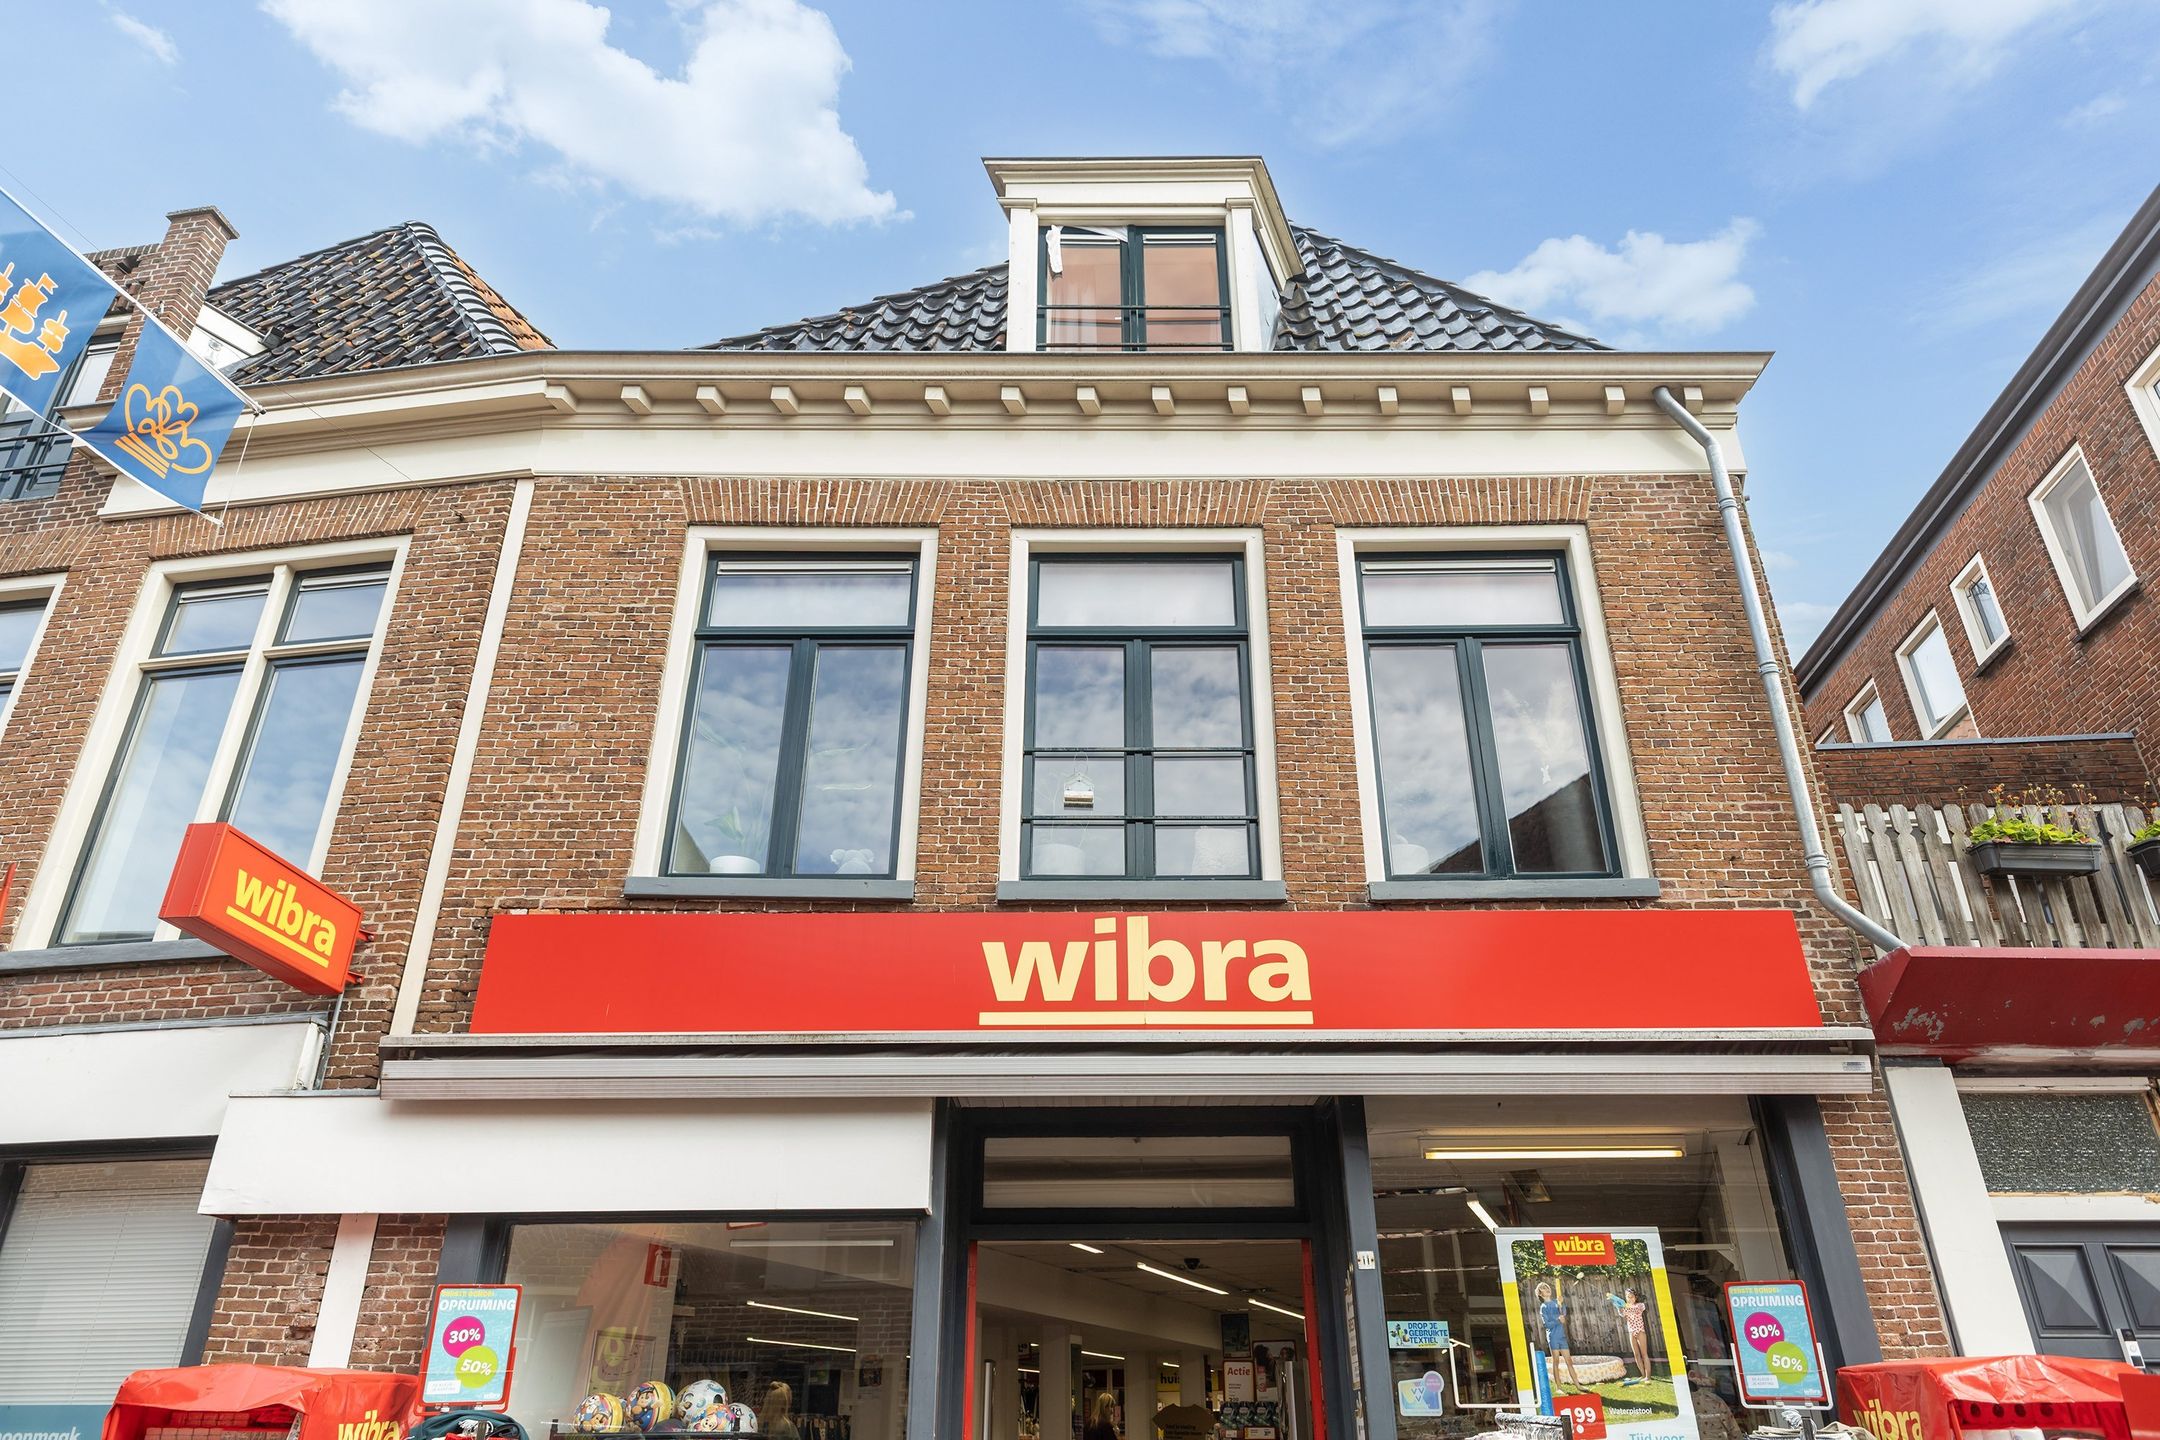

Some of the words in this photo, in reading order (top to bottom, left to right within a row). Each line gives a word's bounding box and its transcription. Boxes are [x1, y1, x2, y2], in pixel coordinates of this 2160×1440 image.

[234, 868, 337, 957] wibra
[980, 915, 1313, 1003] wibra
[1553, 1235, 1605, 1252] wibra
[439, 1298, 516, 1311] OPRUIMING
[1731, 1294, 1805, 1308] OPRUIMING
[1407, 1322, 1428, 1330] DROP
[1429, 1322, 1438, 1330] JE
[1408, 1329, 1449, 1337] GEBRUIKTE
[1749, 1324, 1781, 1339] 30%
[448, 1328, 481, 1344] 30%
[1409, 1336, 1439, 1344] TEXTIEL
[460, 1358, 492, 1376] 50%
[1771, 1354, 1803, 1372] 50%
[1227, 1366, 1252, 1376] Actie
[1608, 1406, 1653, 1417] Waterpistool
[337, 1409, 400, 1440] wibra
[0, 1426, 80, 1440] oonmaak
